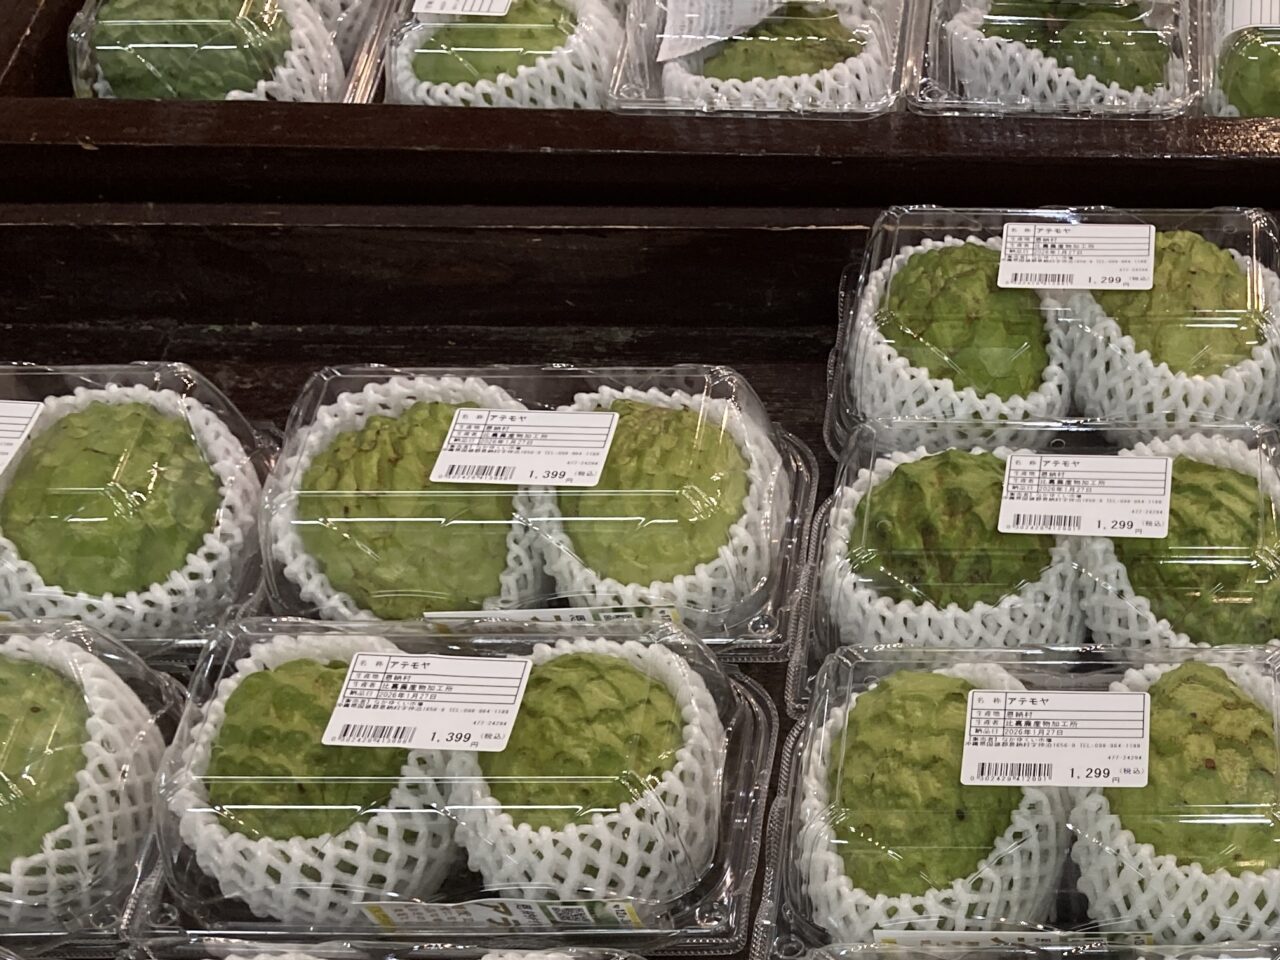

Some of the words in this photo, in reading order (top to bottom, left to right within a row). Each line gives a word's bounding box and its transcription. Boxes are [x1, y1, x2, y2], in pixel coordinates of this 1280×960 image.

[1087, 276, 1122, 285] 1,299
[527, 469, 567, 480] 1,399
[1096, 519, 1134, 530] 1,299
[428, 731, 473, 744] 1,399
[1069, 767, 1111, 780] 1,299
